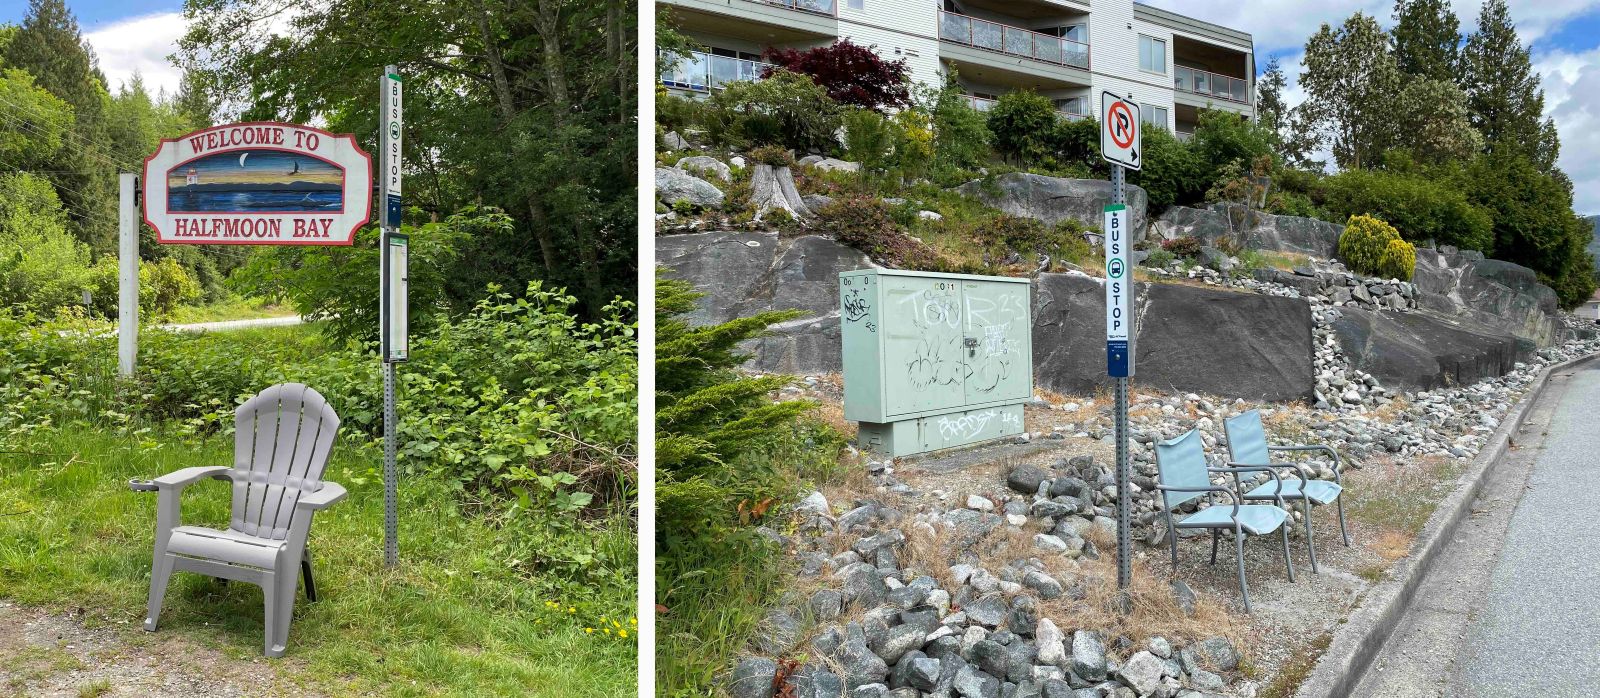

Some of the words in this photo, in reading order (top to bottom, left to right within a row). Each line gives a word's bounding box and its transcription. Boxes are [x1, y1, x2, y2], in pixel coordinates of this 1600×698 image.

[190, 127, 284, 154] WELCOME
[294, 130, 319, 151] TO
[174, 218, 282, 238] HALFMOON
[293, 218, 334, 238] BAY
[1111, 218, 1120, 254] BUS
[1112, 282, 1121, 331] STOP
